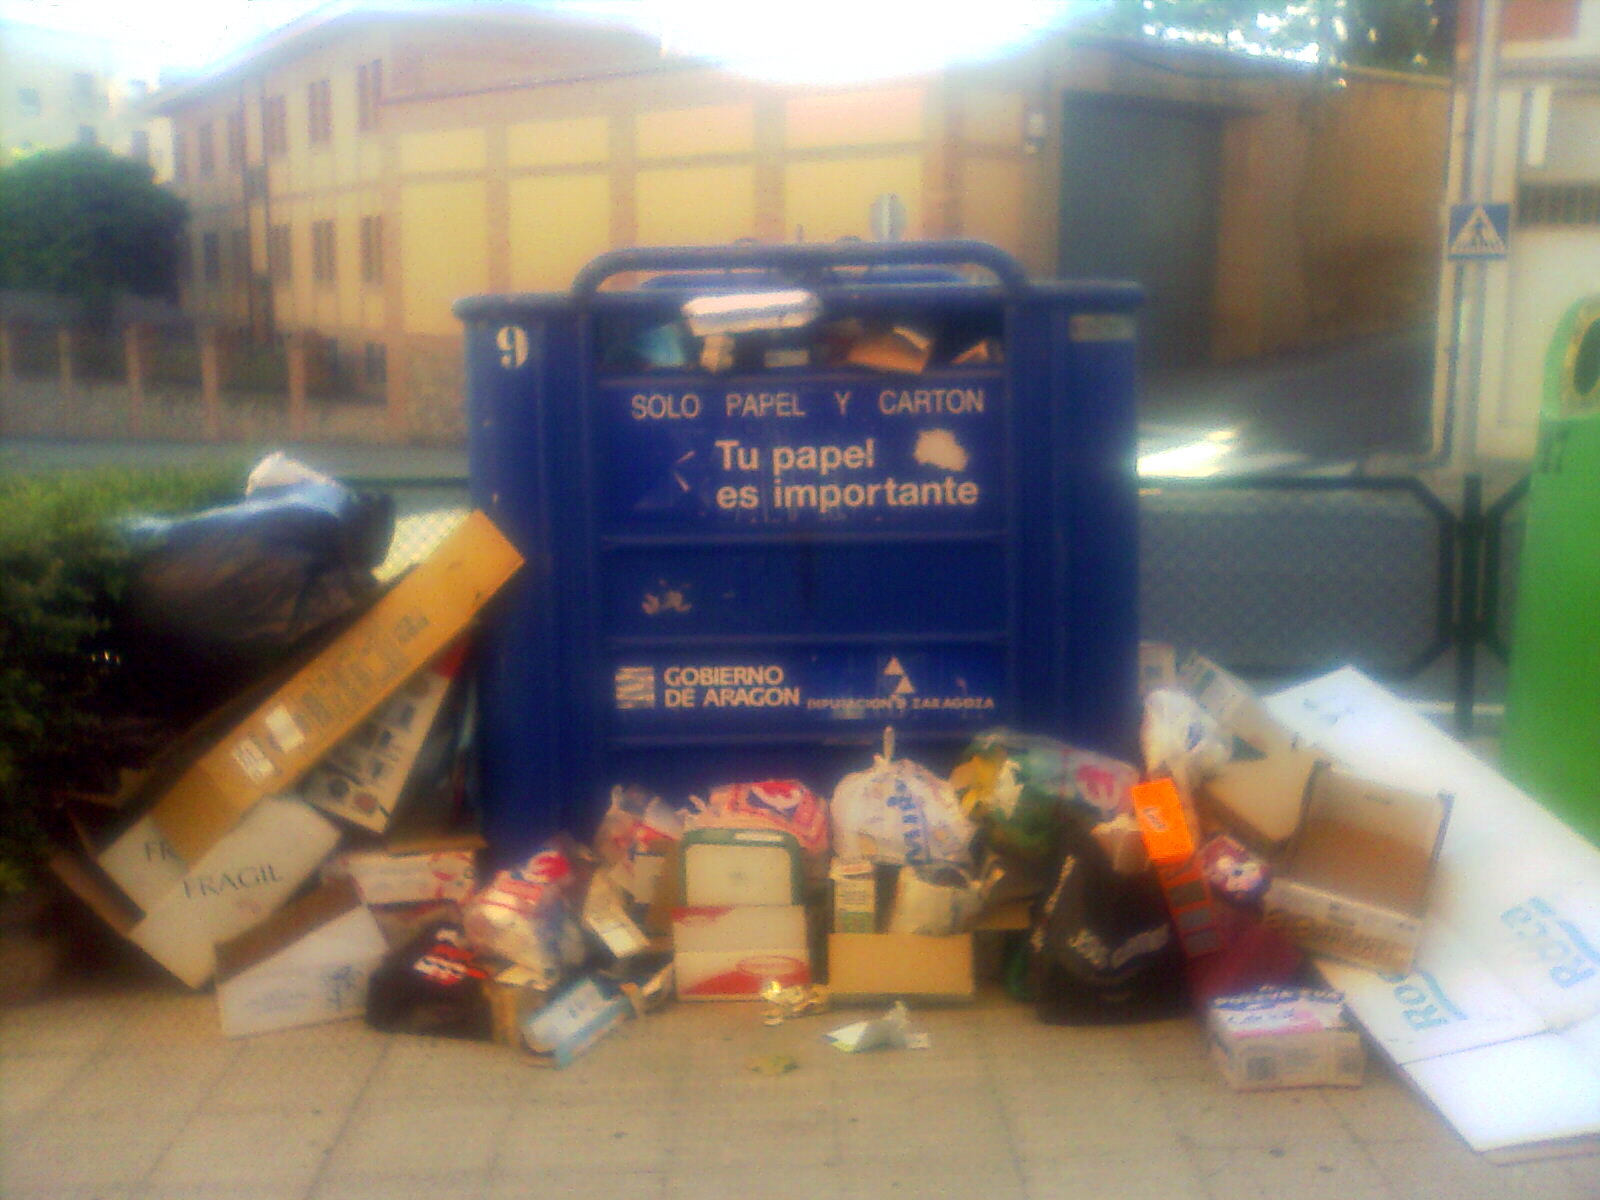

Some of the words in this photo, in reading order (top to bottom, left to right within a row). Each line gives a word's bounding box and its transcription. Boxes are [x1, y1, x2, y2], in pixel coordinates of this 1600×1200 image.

[496, 326, 529, 369] 9
[631, 393, 700, 420] SOLO
[725, 391, 806, 417] PAPEL
[835, 390, 852, 416] Y
[879, 387, 984, 415] CARTON
[714, 438, 760, 471] Tu
[772, 437, 876, 475] papel
[716, 484, 759, 509] es
[772, 477, 980, 514] importante
[663, 665, 784, 687] GOBIERNO
[664, 688, 696, 708] DE
[703, 686, 800, 708] ARAGON
